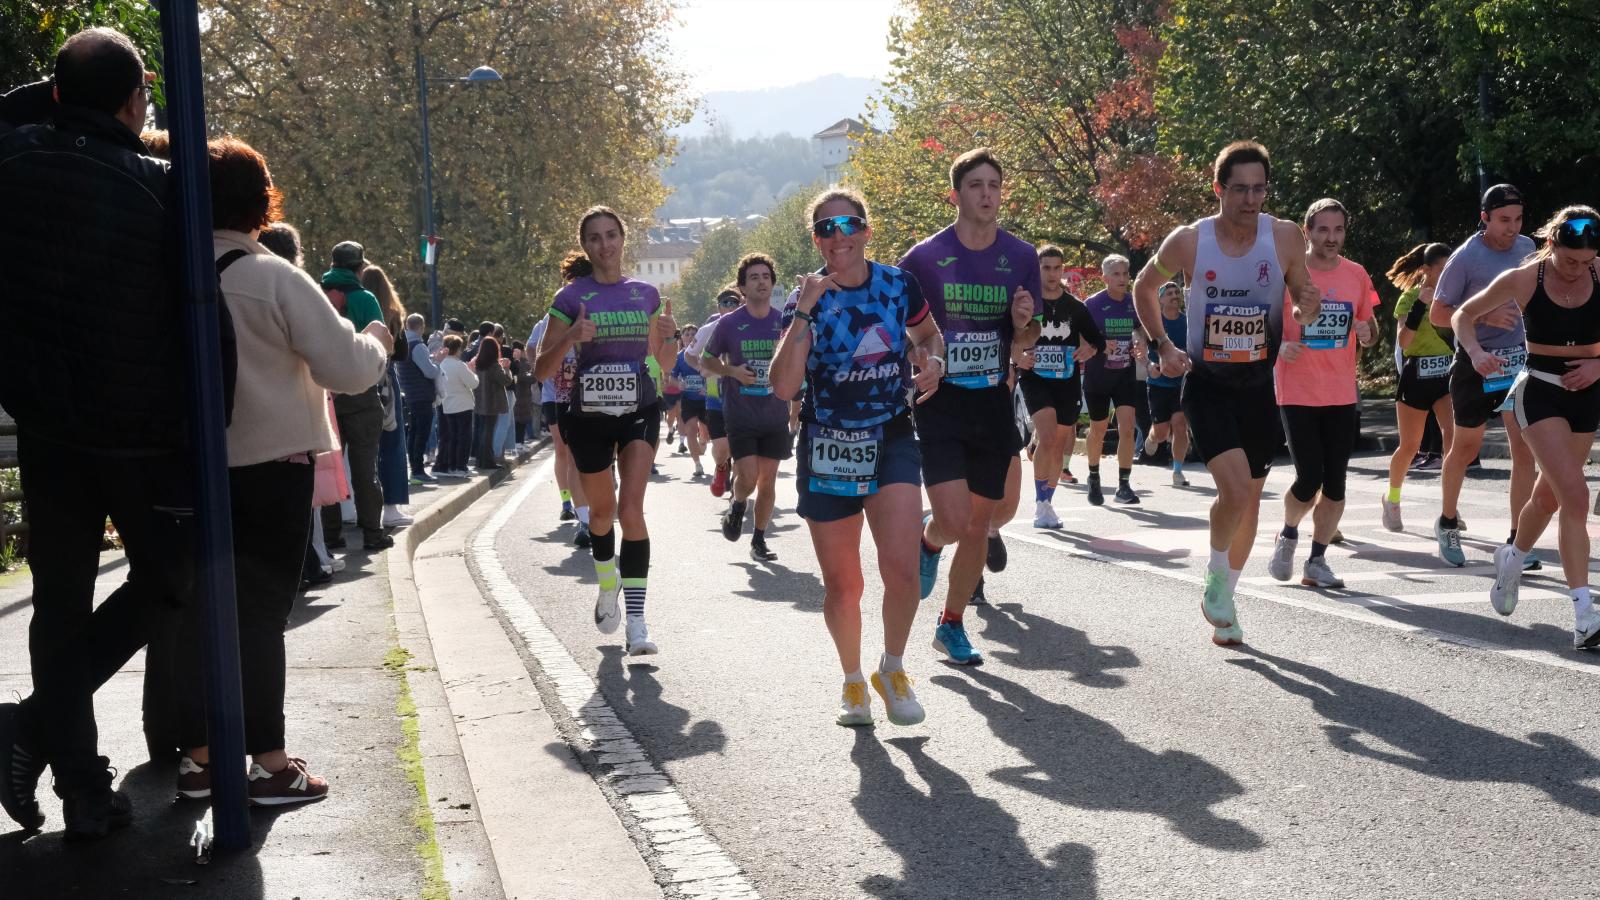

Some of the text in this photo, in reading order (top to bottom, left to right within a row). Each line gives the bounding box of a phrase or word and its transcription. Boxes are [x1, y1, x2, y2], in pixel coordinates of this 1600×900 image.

[944, 283, 1007, 303] BEHOBIA
[1221, 288, 1250, 297] Irizar
[945, 302, 963, 312] SAN
[1227, 306, 1260, 315] Joma
[590, 311, 649, 325] BEHOBIA
[1308, 314, 1347, 328] 239
[1212, 319, 1264, 335] 14802
[965, 332, 998, 342] Joma
[741, 340, 773, 351] BEHOB
[950, 344, 998, 362] 10973
[598, 364, 632, 373] Joma
[1421, 356, 1449, 369] 8558
[834, 362, 900, 382] OHANA
[585, 377, 635, 392] 28035
[815, 443, 876, 464] 10435
[833, 466, 857, 474] PAULA
